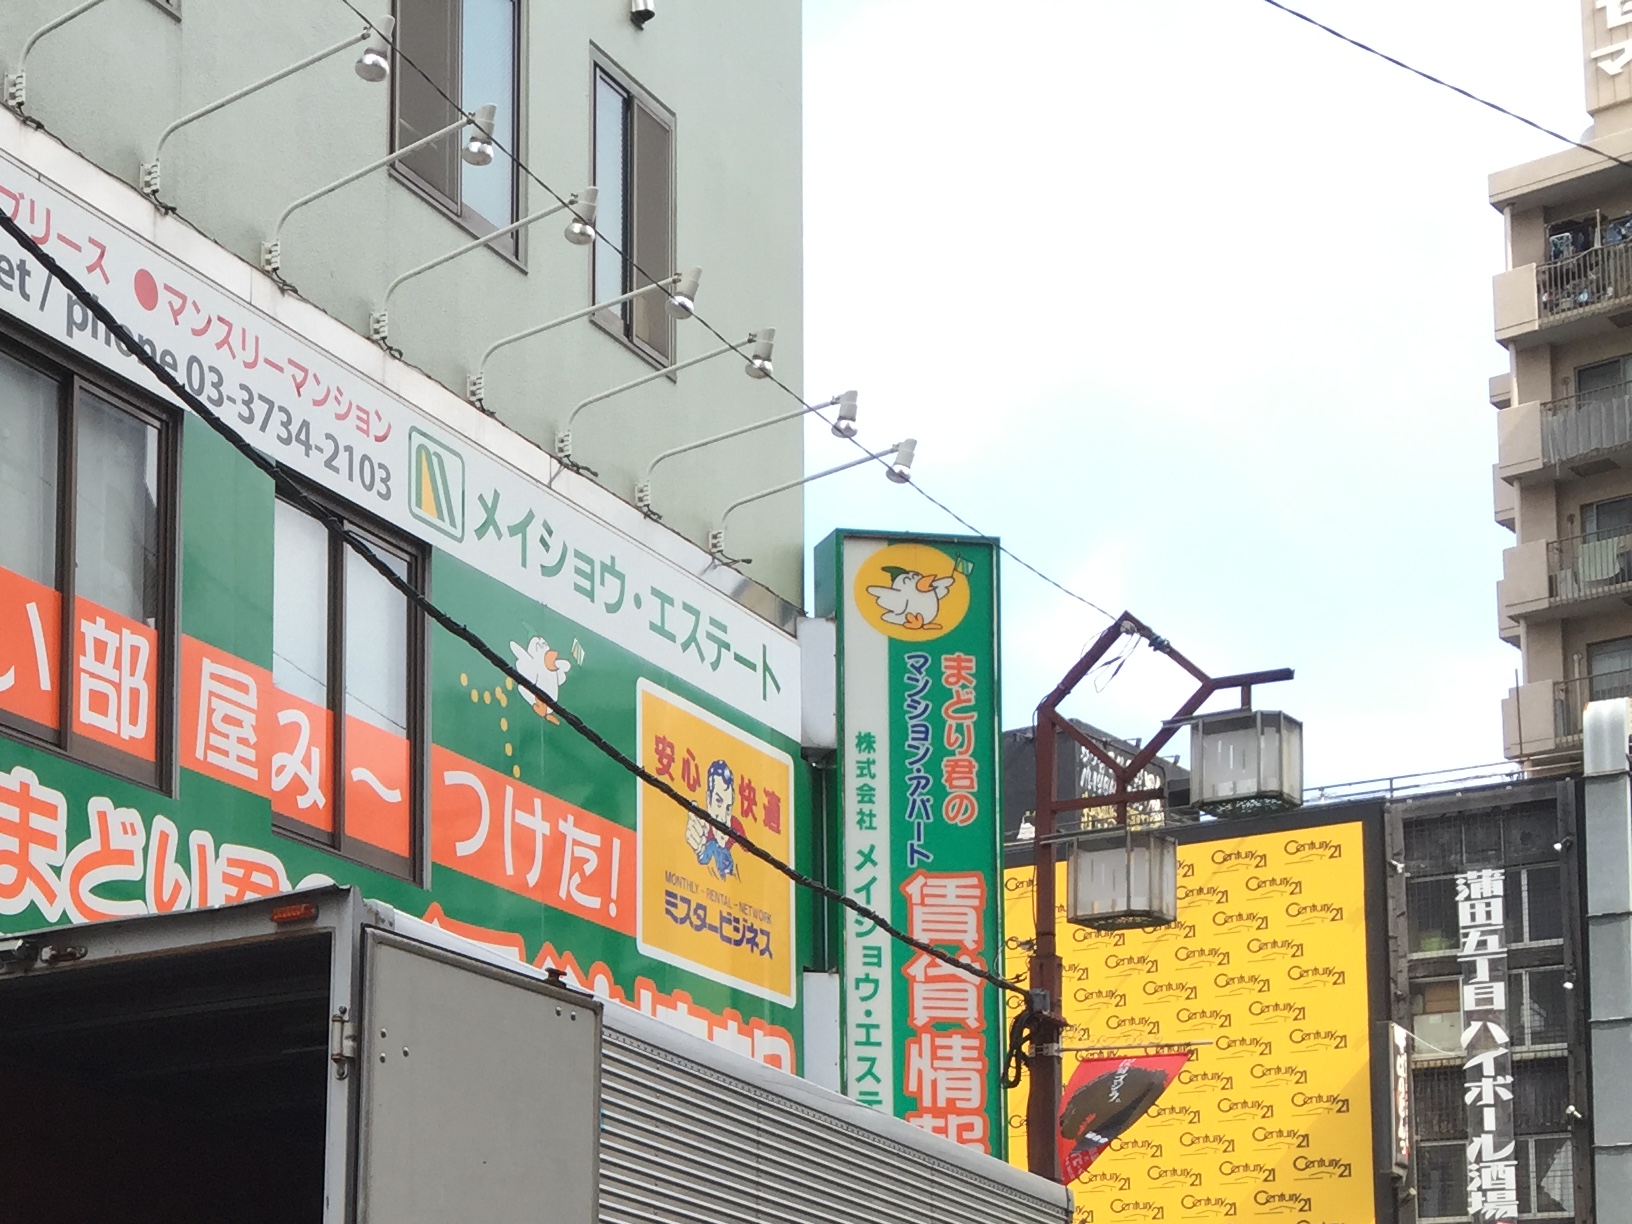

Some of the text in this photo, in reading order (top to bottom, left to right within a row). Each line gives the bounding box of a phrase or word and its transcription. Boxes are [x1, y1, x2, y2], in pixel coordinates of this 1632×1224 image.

[185, 354, 392, 501] 03-3734-2103
[855, 730, 878, 832] 株式会社
[941, 652, 979, 827] まどり君の
